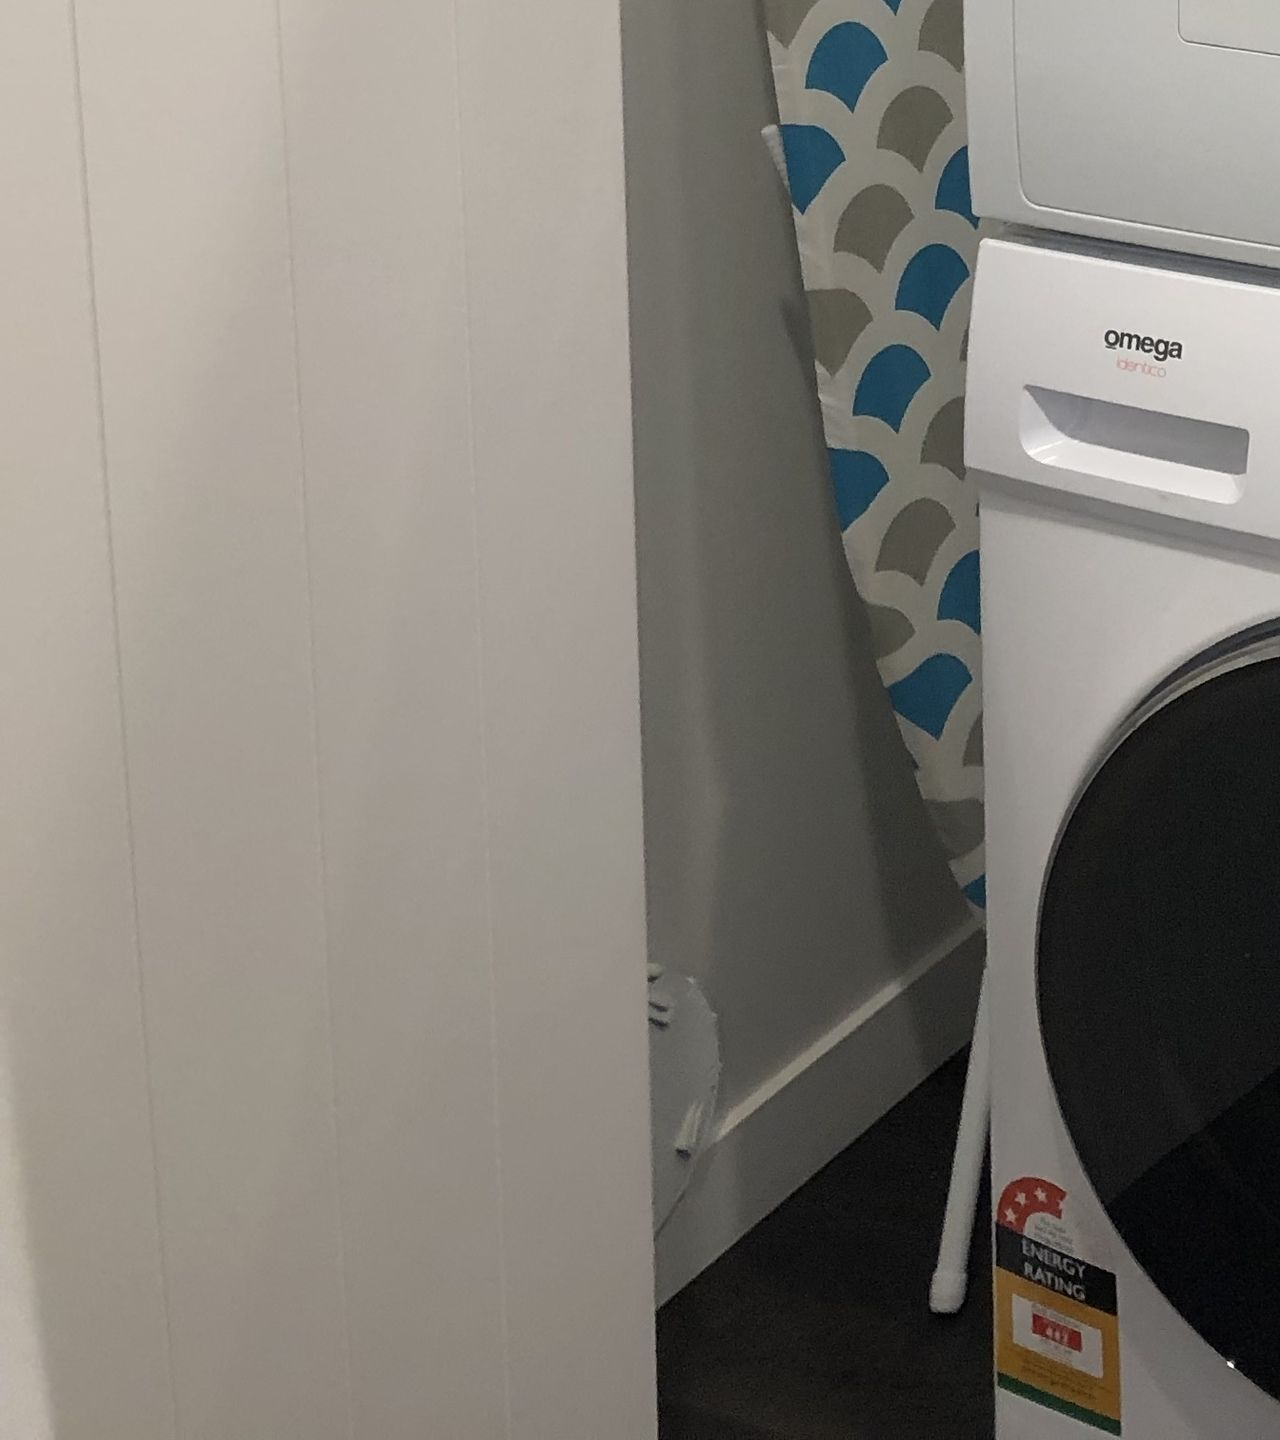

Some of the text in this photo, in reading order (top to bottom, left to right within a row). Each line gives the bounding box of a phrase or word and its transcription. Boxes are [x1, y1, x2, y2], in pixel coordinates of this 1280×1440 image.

[1104, 329, 1183, 362] omega
[1022, 1237, 1086, 1279] ENERGY
[1024, 1261, 1086, 1300] RATING
